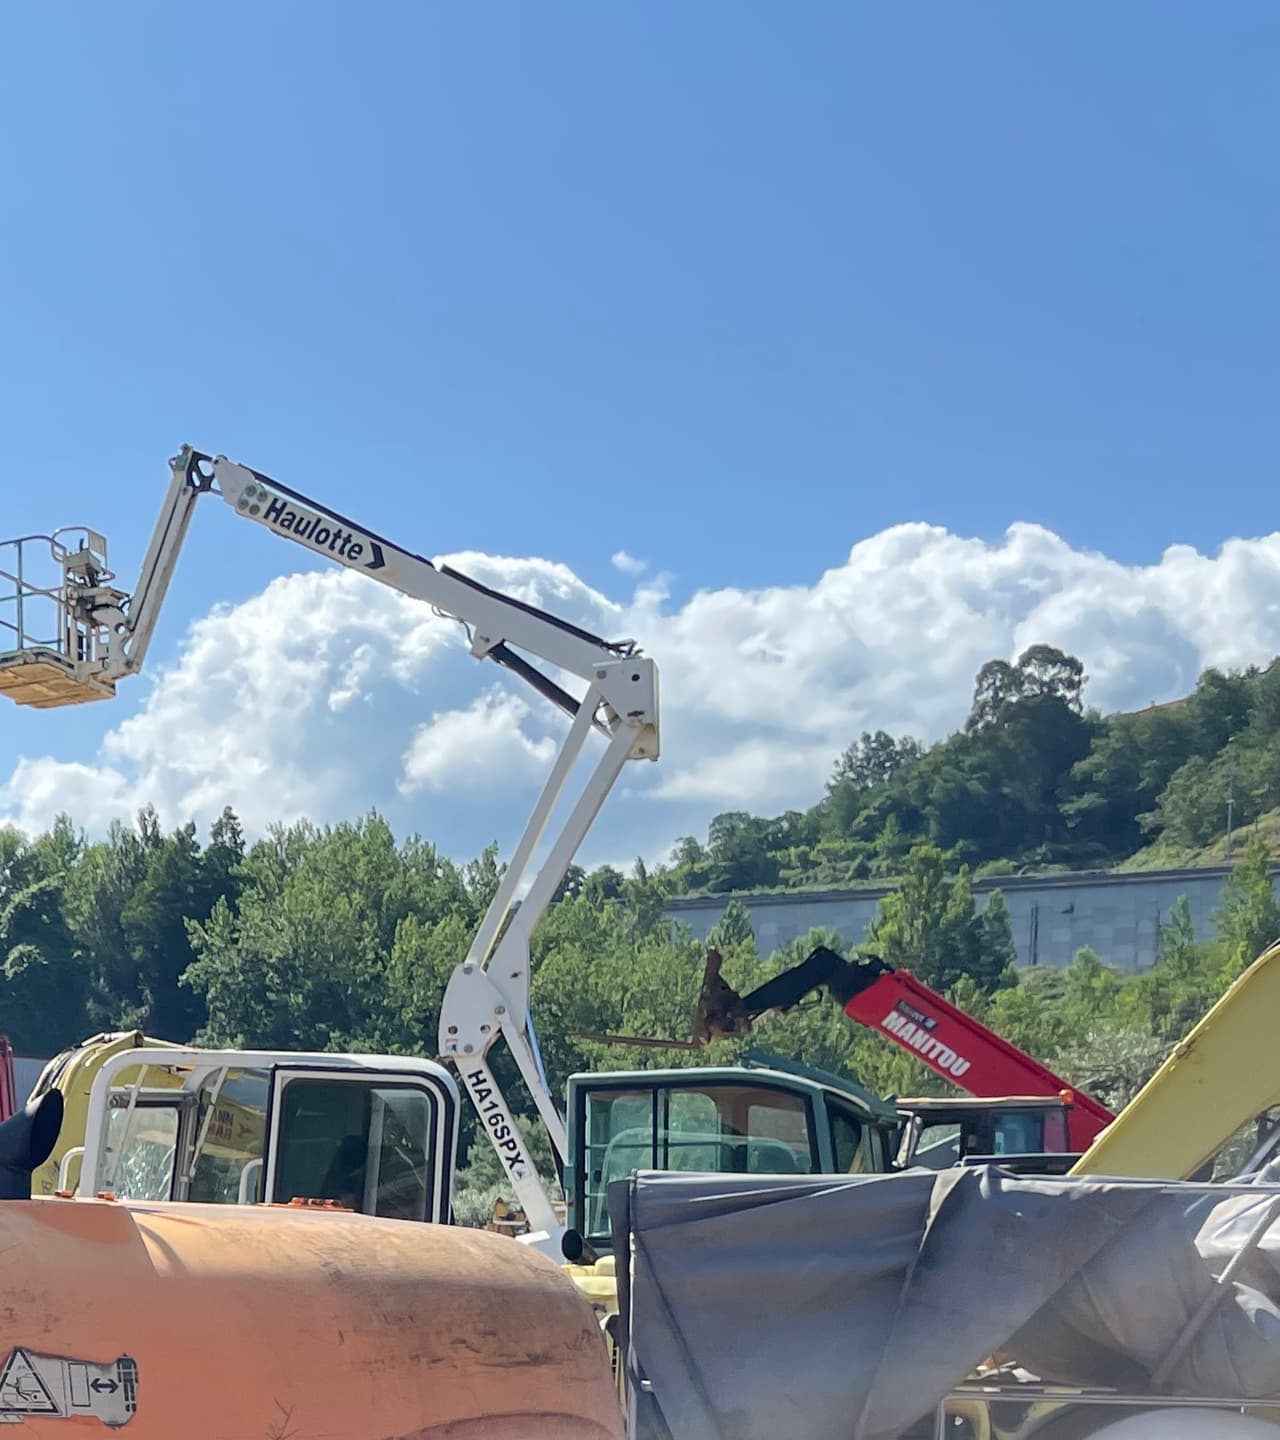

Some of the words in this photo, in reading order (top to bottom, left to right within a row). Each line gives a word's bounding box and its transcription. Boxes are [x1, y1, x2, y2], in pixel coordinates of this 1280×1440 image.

[263, 497, 364, 561] Haulotte
[881, 1011, 971, 1076] MANITOU
[468, 1069, 525, 1169] HA16SPX
